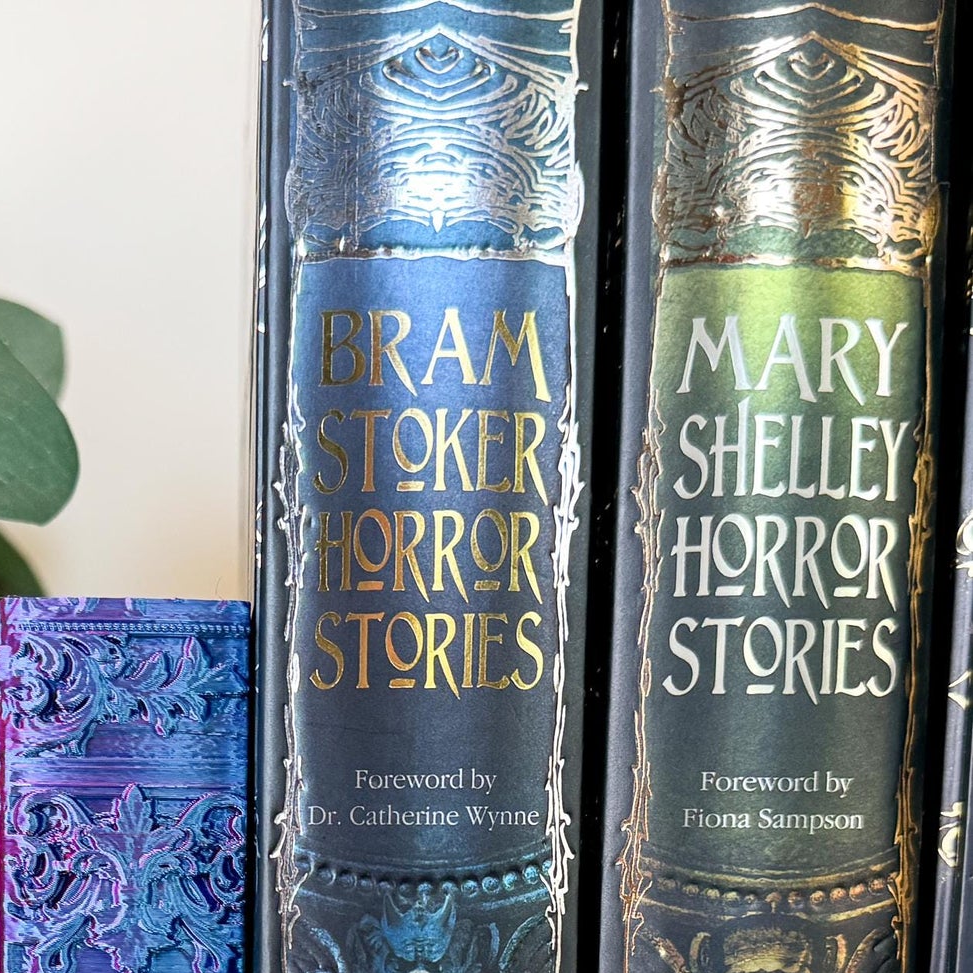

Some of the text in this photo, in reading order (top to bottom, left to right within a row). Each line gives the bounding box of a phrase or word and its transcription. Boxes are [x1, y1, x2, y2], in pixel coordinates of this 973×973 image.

[319, 309, 551, 402] BRAM
[676, 315, 909, 405] MARY
[313, 409, 548, 506] STOKER
[673, 397, 910, 501] SHELLEY
[314, 509, 543, 604] HORROR
[671, 514, 897, 612] HORROR
[309, 611, 545, 700] STORIES
[662, 616, 899, 705] STORIES
[308, 805, 540, 831] Dr. Catherine Wynne
[355, 768, 497, 794] Foreword by
[682, 808, 864, 835] Fiona Sampson
[700, 771, 854, 798] Foreword by
